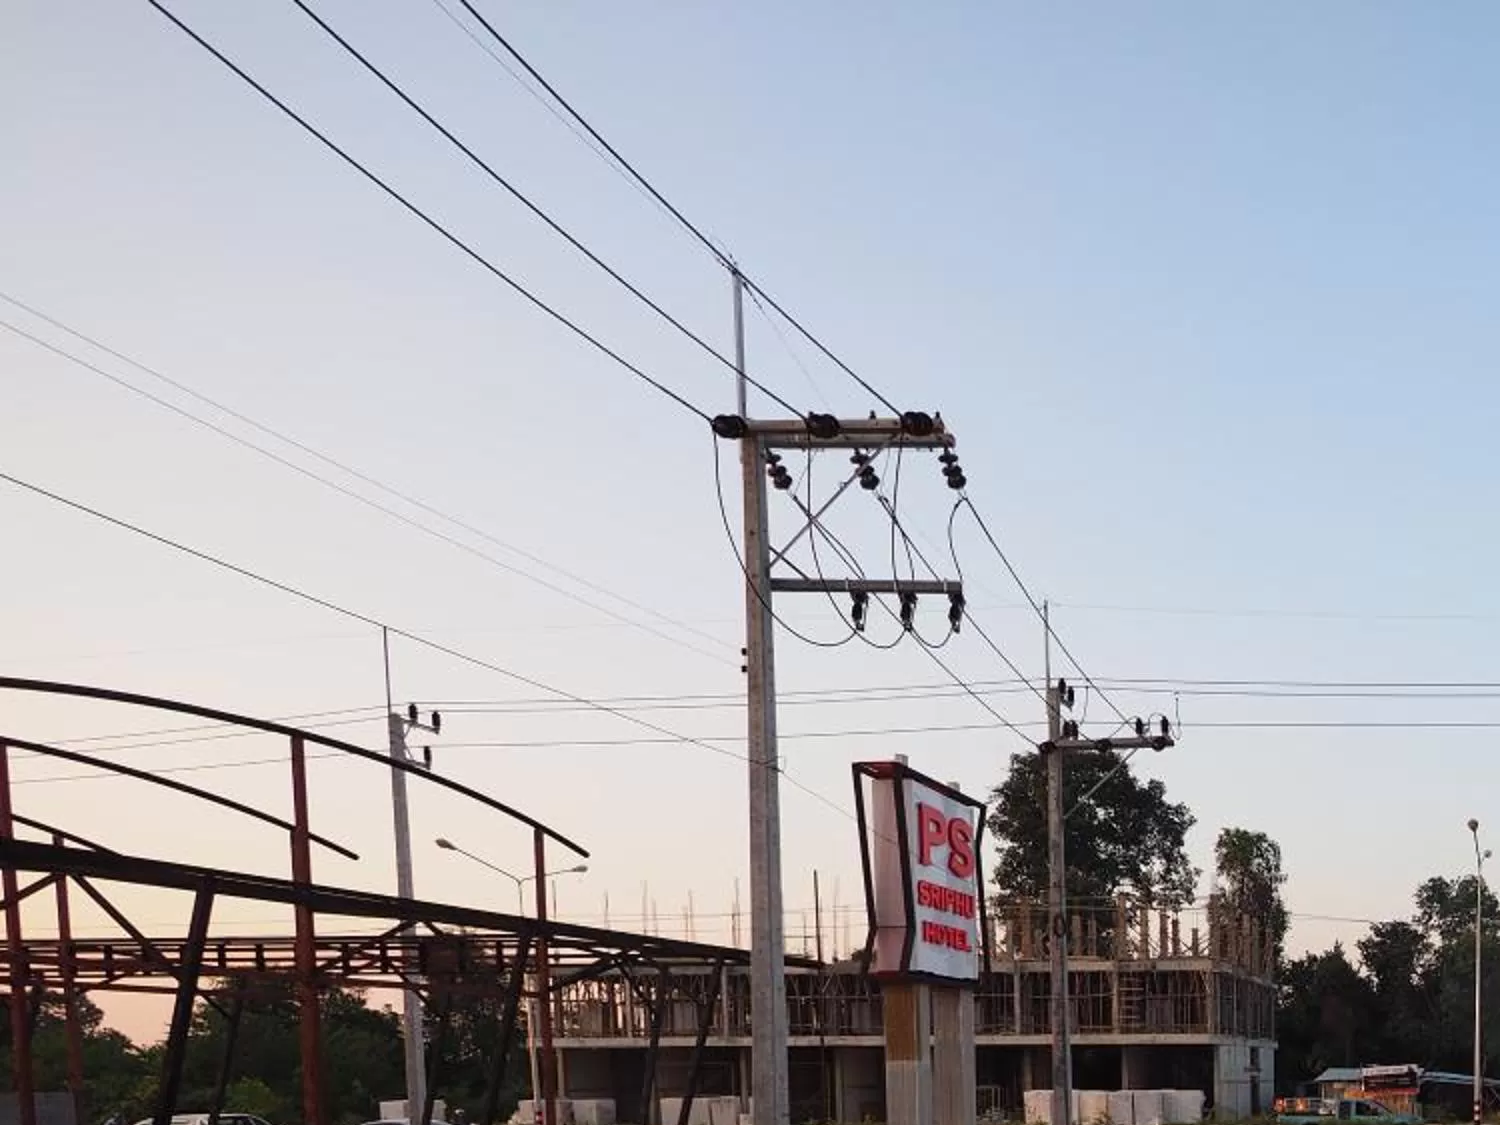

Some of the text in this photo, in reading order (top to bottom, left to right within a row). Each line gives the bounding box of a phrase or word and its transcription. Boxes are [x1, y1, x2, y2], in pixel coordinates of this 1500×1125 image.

[918, 801, 974, 878] PS
[918, 880, 974, 919] SRIPHU
[922, 920, 972, 952] HOTEL
